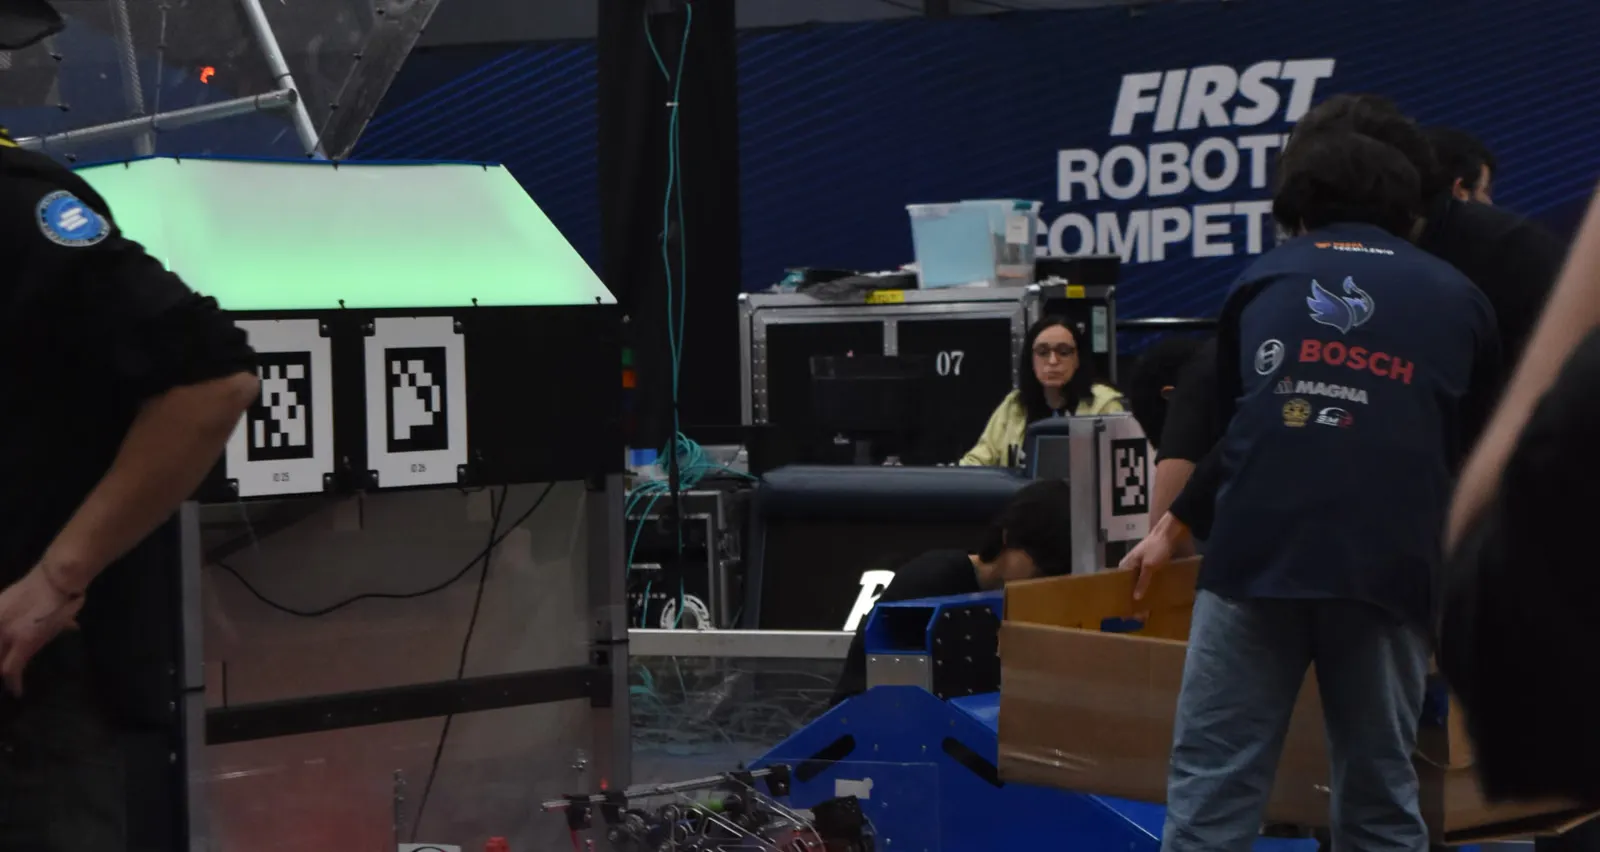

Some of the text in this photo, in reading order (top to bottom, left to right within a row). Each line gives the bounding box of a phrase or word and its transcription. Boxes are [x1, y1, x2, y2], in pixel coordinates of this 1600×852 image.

[1110, 58, 1336, 136] FIRST
[1057, 133, 1291, 202] ROBOT
[1036, 200, 1276, 264] OMPET
[936, 350, 965, 376] 07
[1298, 339, 1415, 384] BOSCH
[1295, 380, 1369, 405] MAGNA
